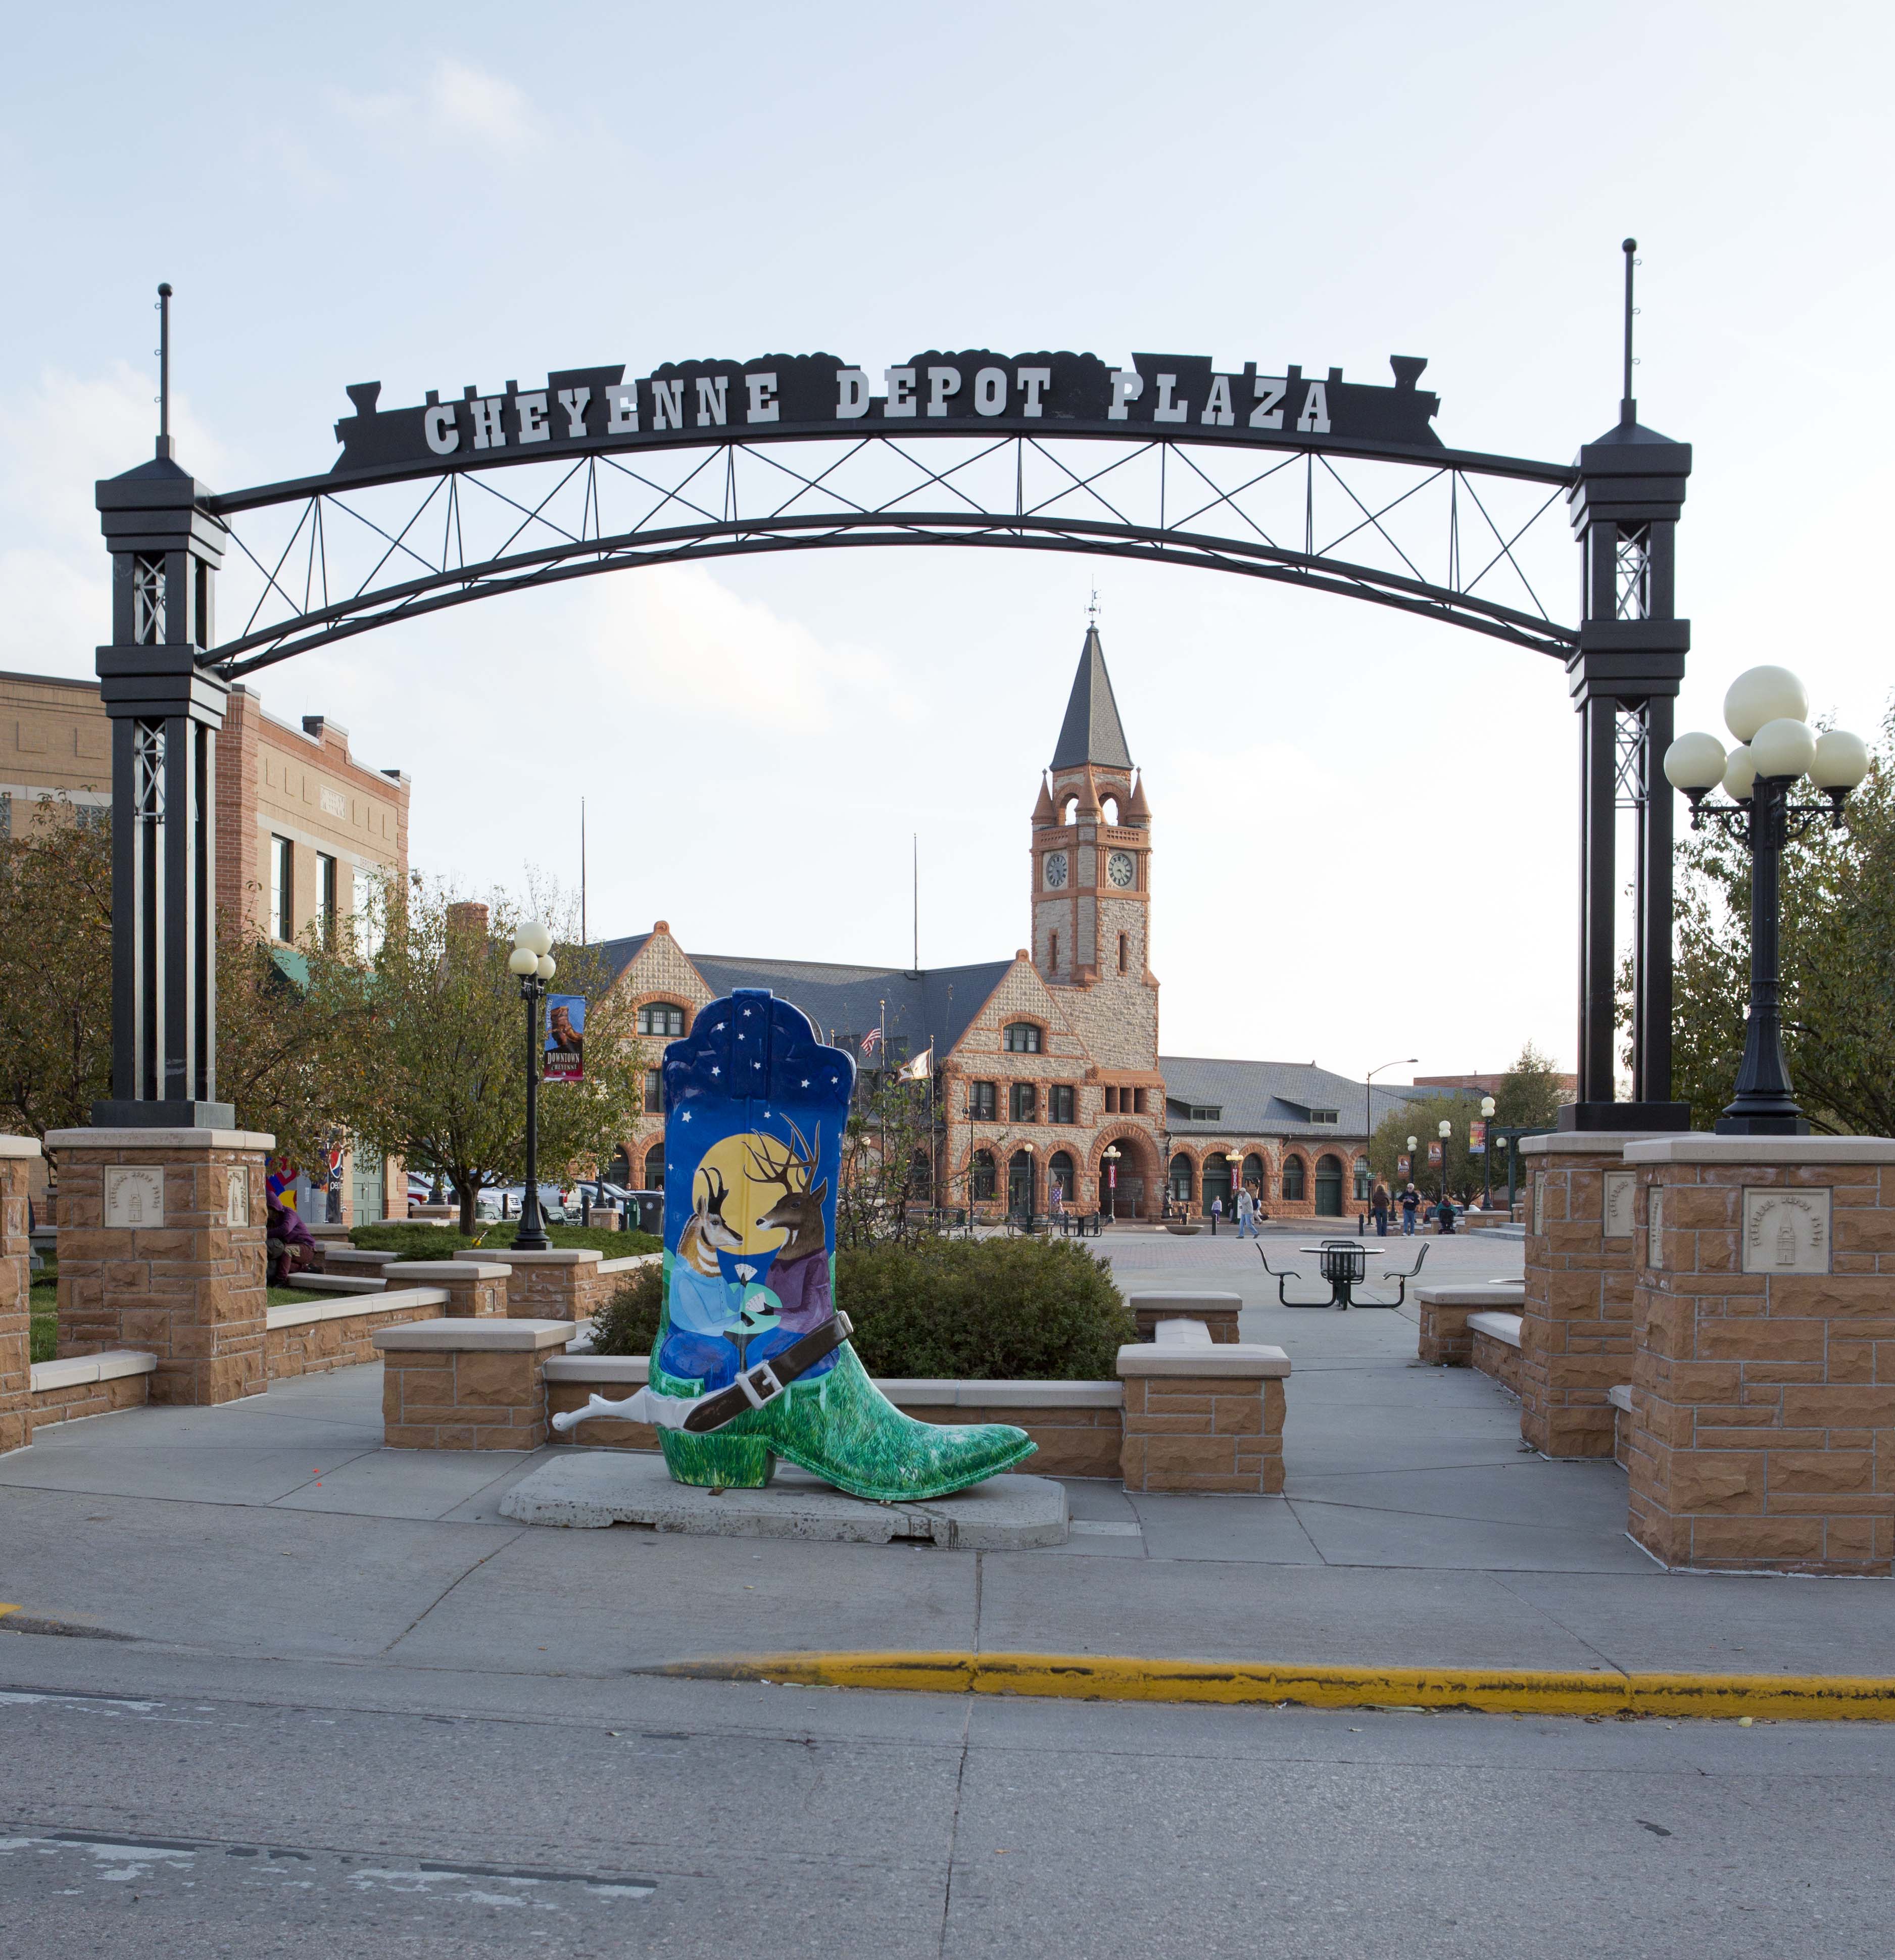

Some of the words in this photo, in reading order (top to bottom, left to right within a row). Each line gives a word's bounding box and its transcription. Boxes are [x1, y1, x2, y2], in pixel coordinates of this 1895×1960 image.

[424, 372, 780, 455] CHEYENNE
[835, 367, 1051, 420] DEPOT
[1107, 371, 1332, 433] PLAZA
[548, 1052, 579, 1064] DOWNTOWN
[330, 1182, 342, 1192] pep
